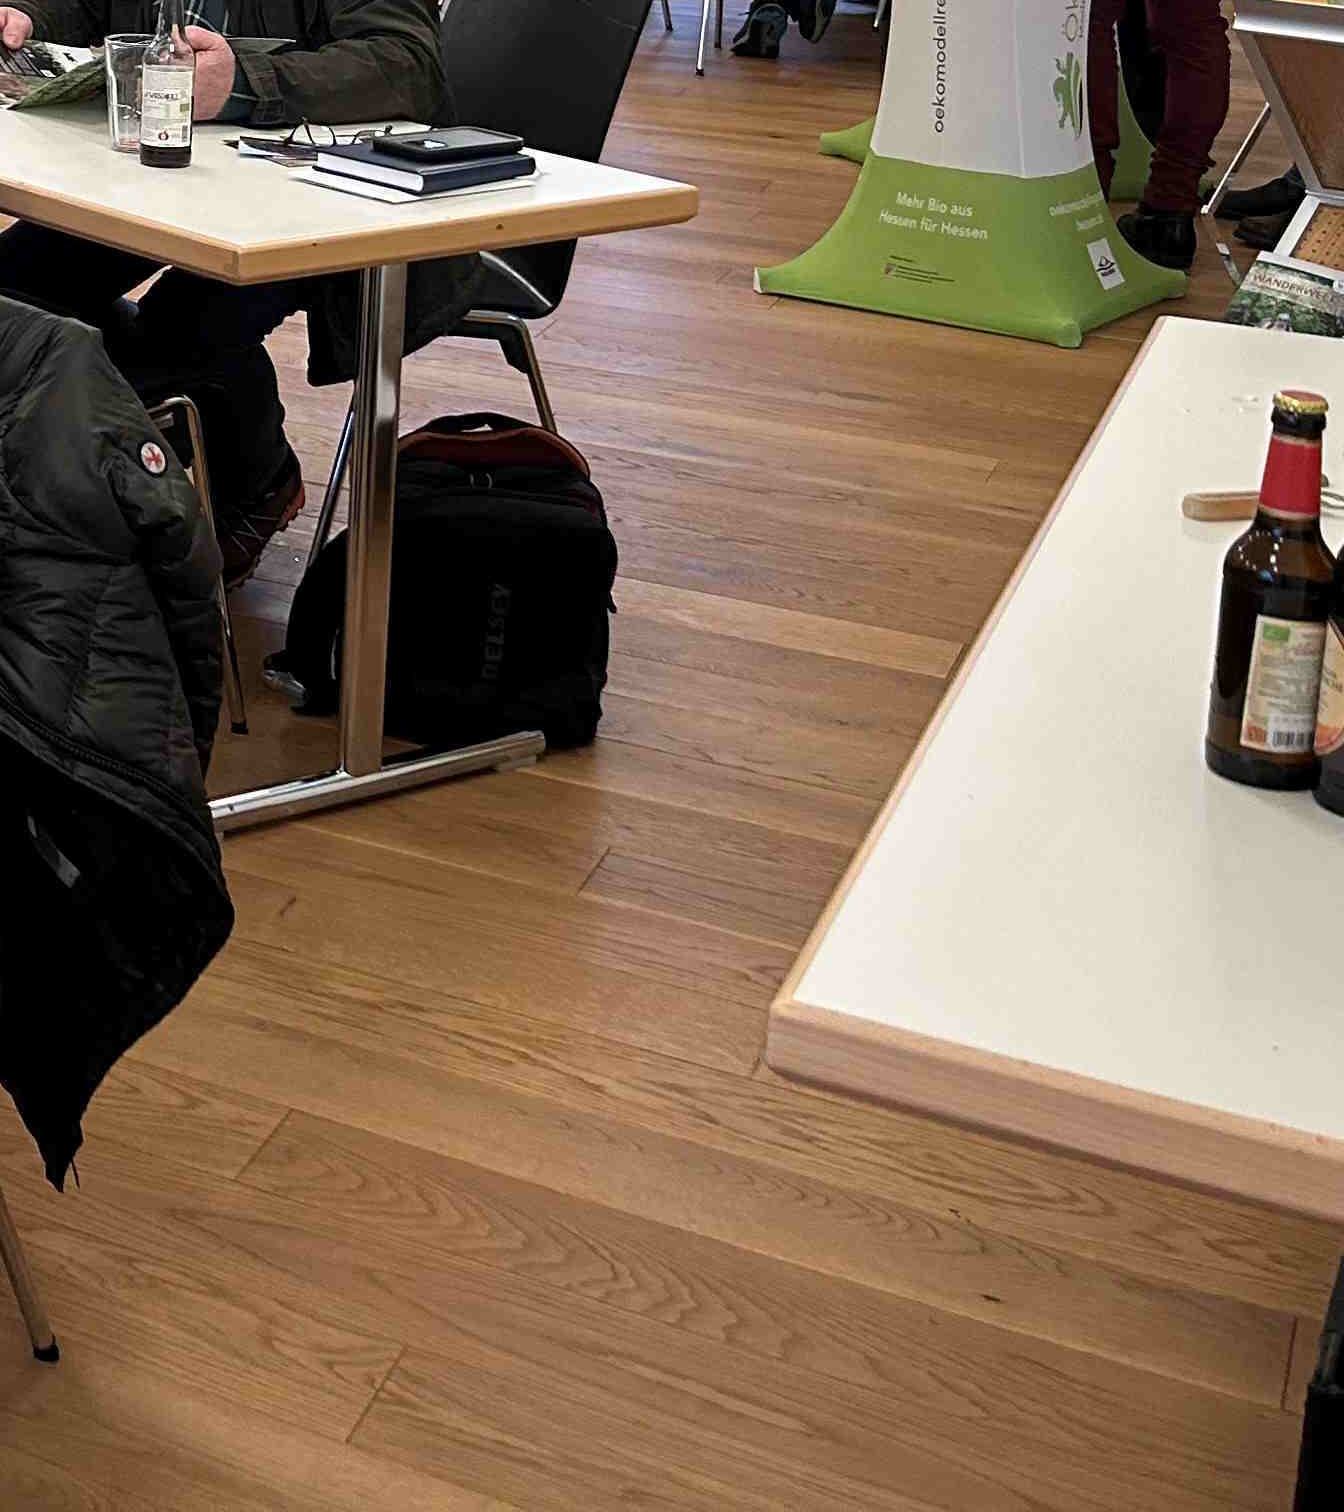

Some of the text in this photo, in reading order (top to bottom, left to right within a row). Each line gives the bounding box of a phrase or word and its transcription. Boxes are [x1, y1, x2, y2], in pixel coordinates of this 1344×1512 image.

[895, 190, 973, 217] Mehr Bio aus
[879, 209, 989, 240] Hessen für Hessen
